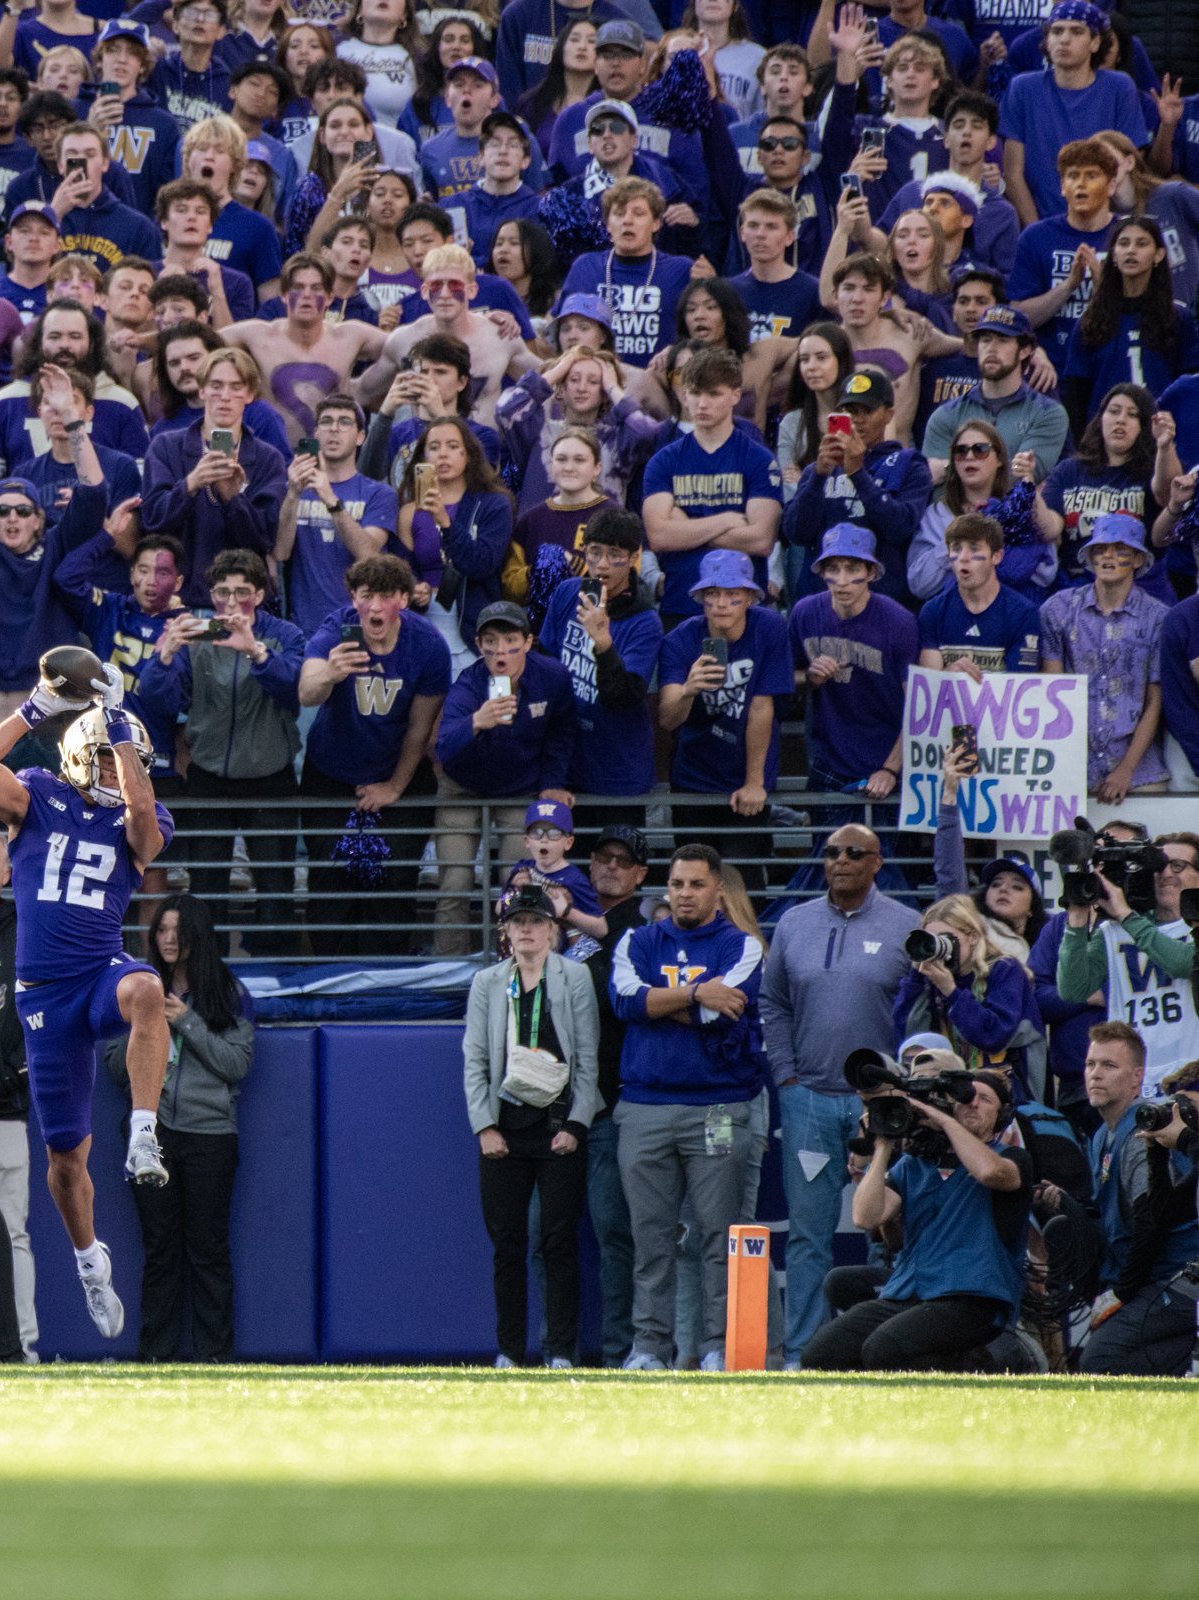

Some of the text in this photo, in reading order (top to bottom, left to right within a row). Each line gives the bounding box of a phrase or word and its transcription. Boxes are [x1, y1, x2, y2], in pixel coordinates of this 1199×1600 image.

[614, 337, 659, 354] ERGY
[354, 676, 403, 716] W
[909, 674, 1077, 740] DAWGS
[979, 747, 1056, 776] NEED
[1025, 778, 1053, 792] TO
[82, 810, 95, 821] W
[536, 803, 558, 817] W
[1001, 793, 1079, 836] WIN
[36, 831, 118, 911] 12
[862, 941, 883, 955] W
[26, 1011, 44, 1031] W
[1130, 992, 1184, 1030] 136
[744, 1238, 765, 1256] W
